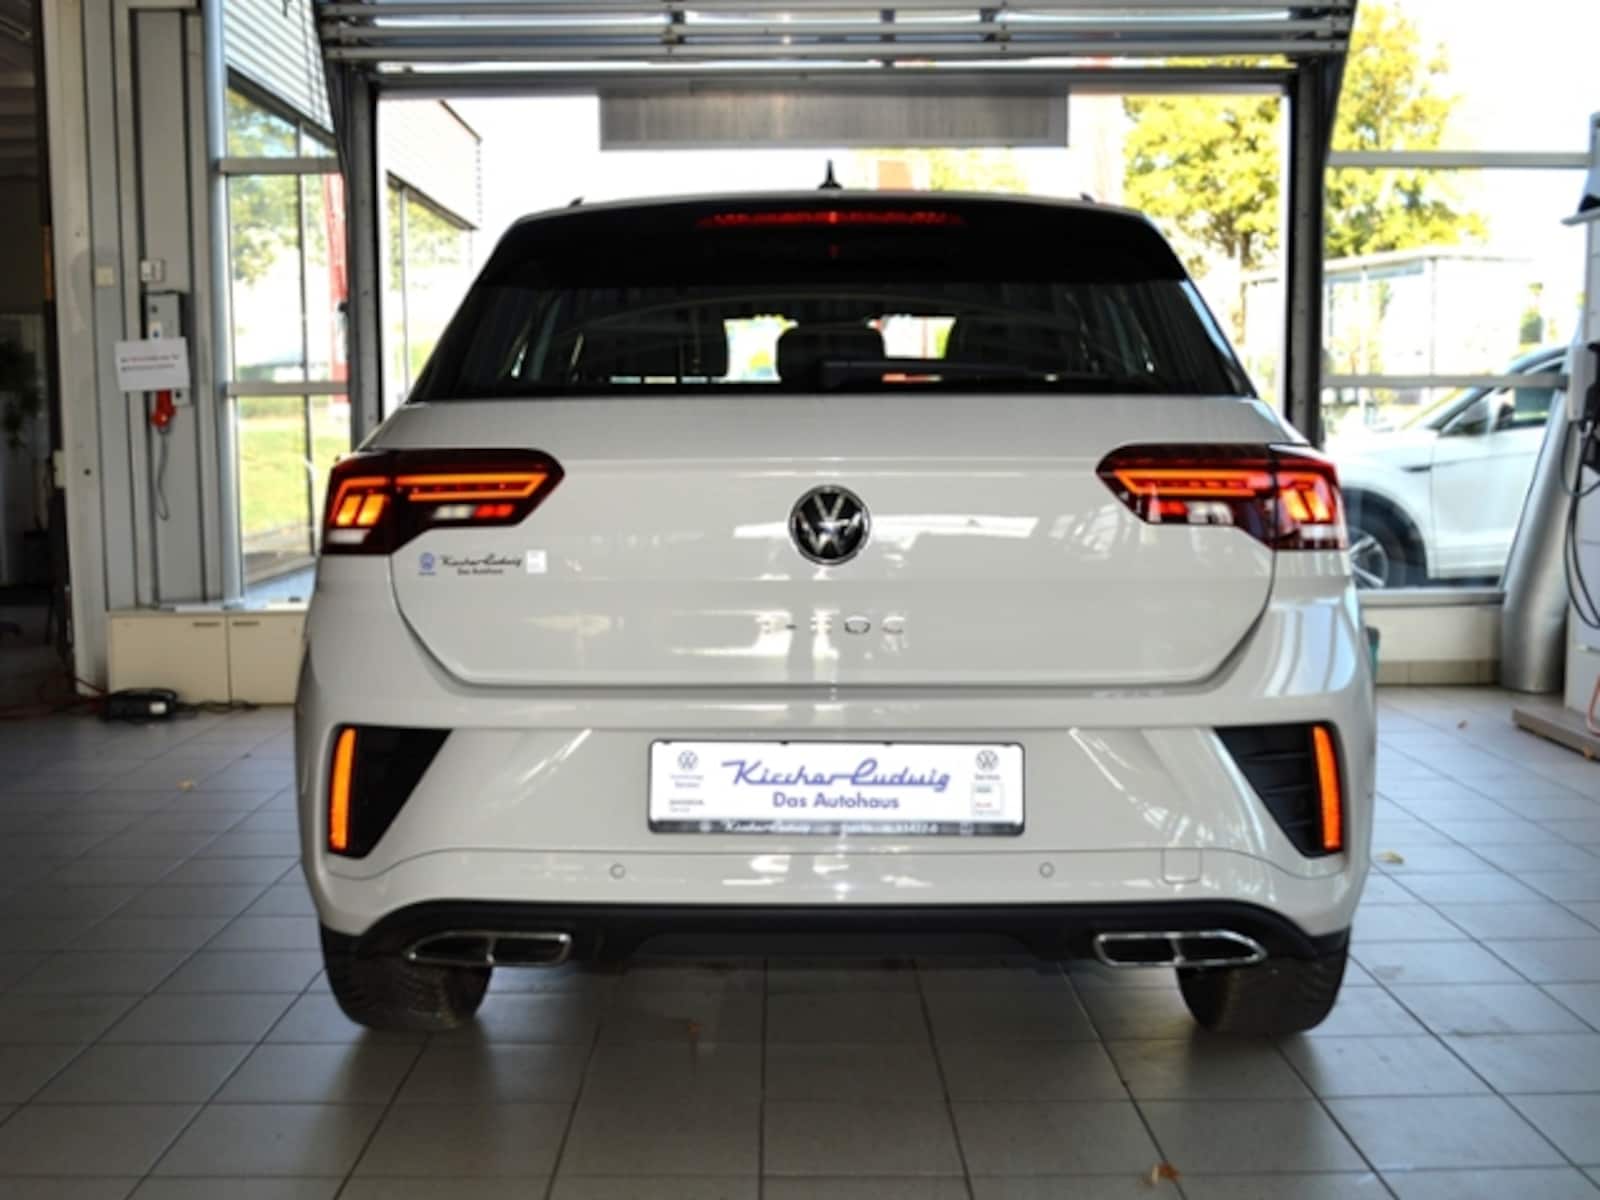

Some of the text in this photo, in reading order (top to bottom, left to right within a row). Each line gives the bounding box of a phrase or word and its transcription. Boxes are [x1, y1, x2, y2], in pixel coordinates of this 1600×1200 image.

[850, 757, 951, 792] Ludwig
[772, 791, 900, 809] Das Autohaus
